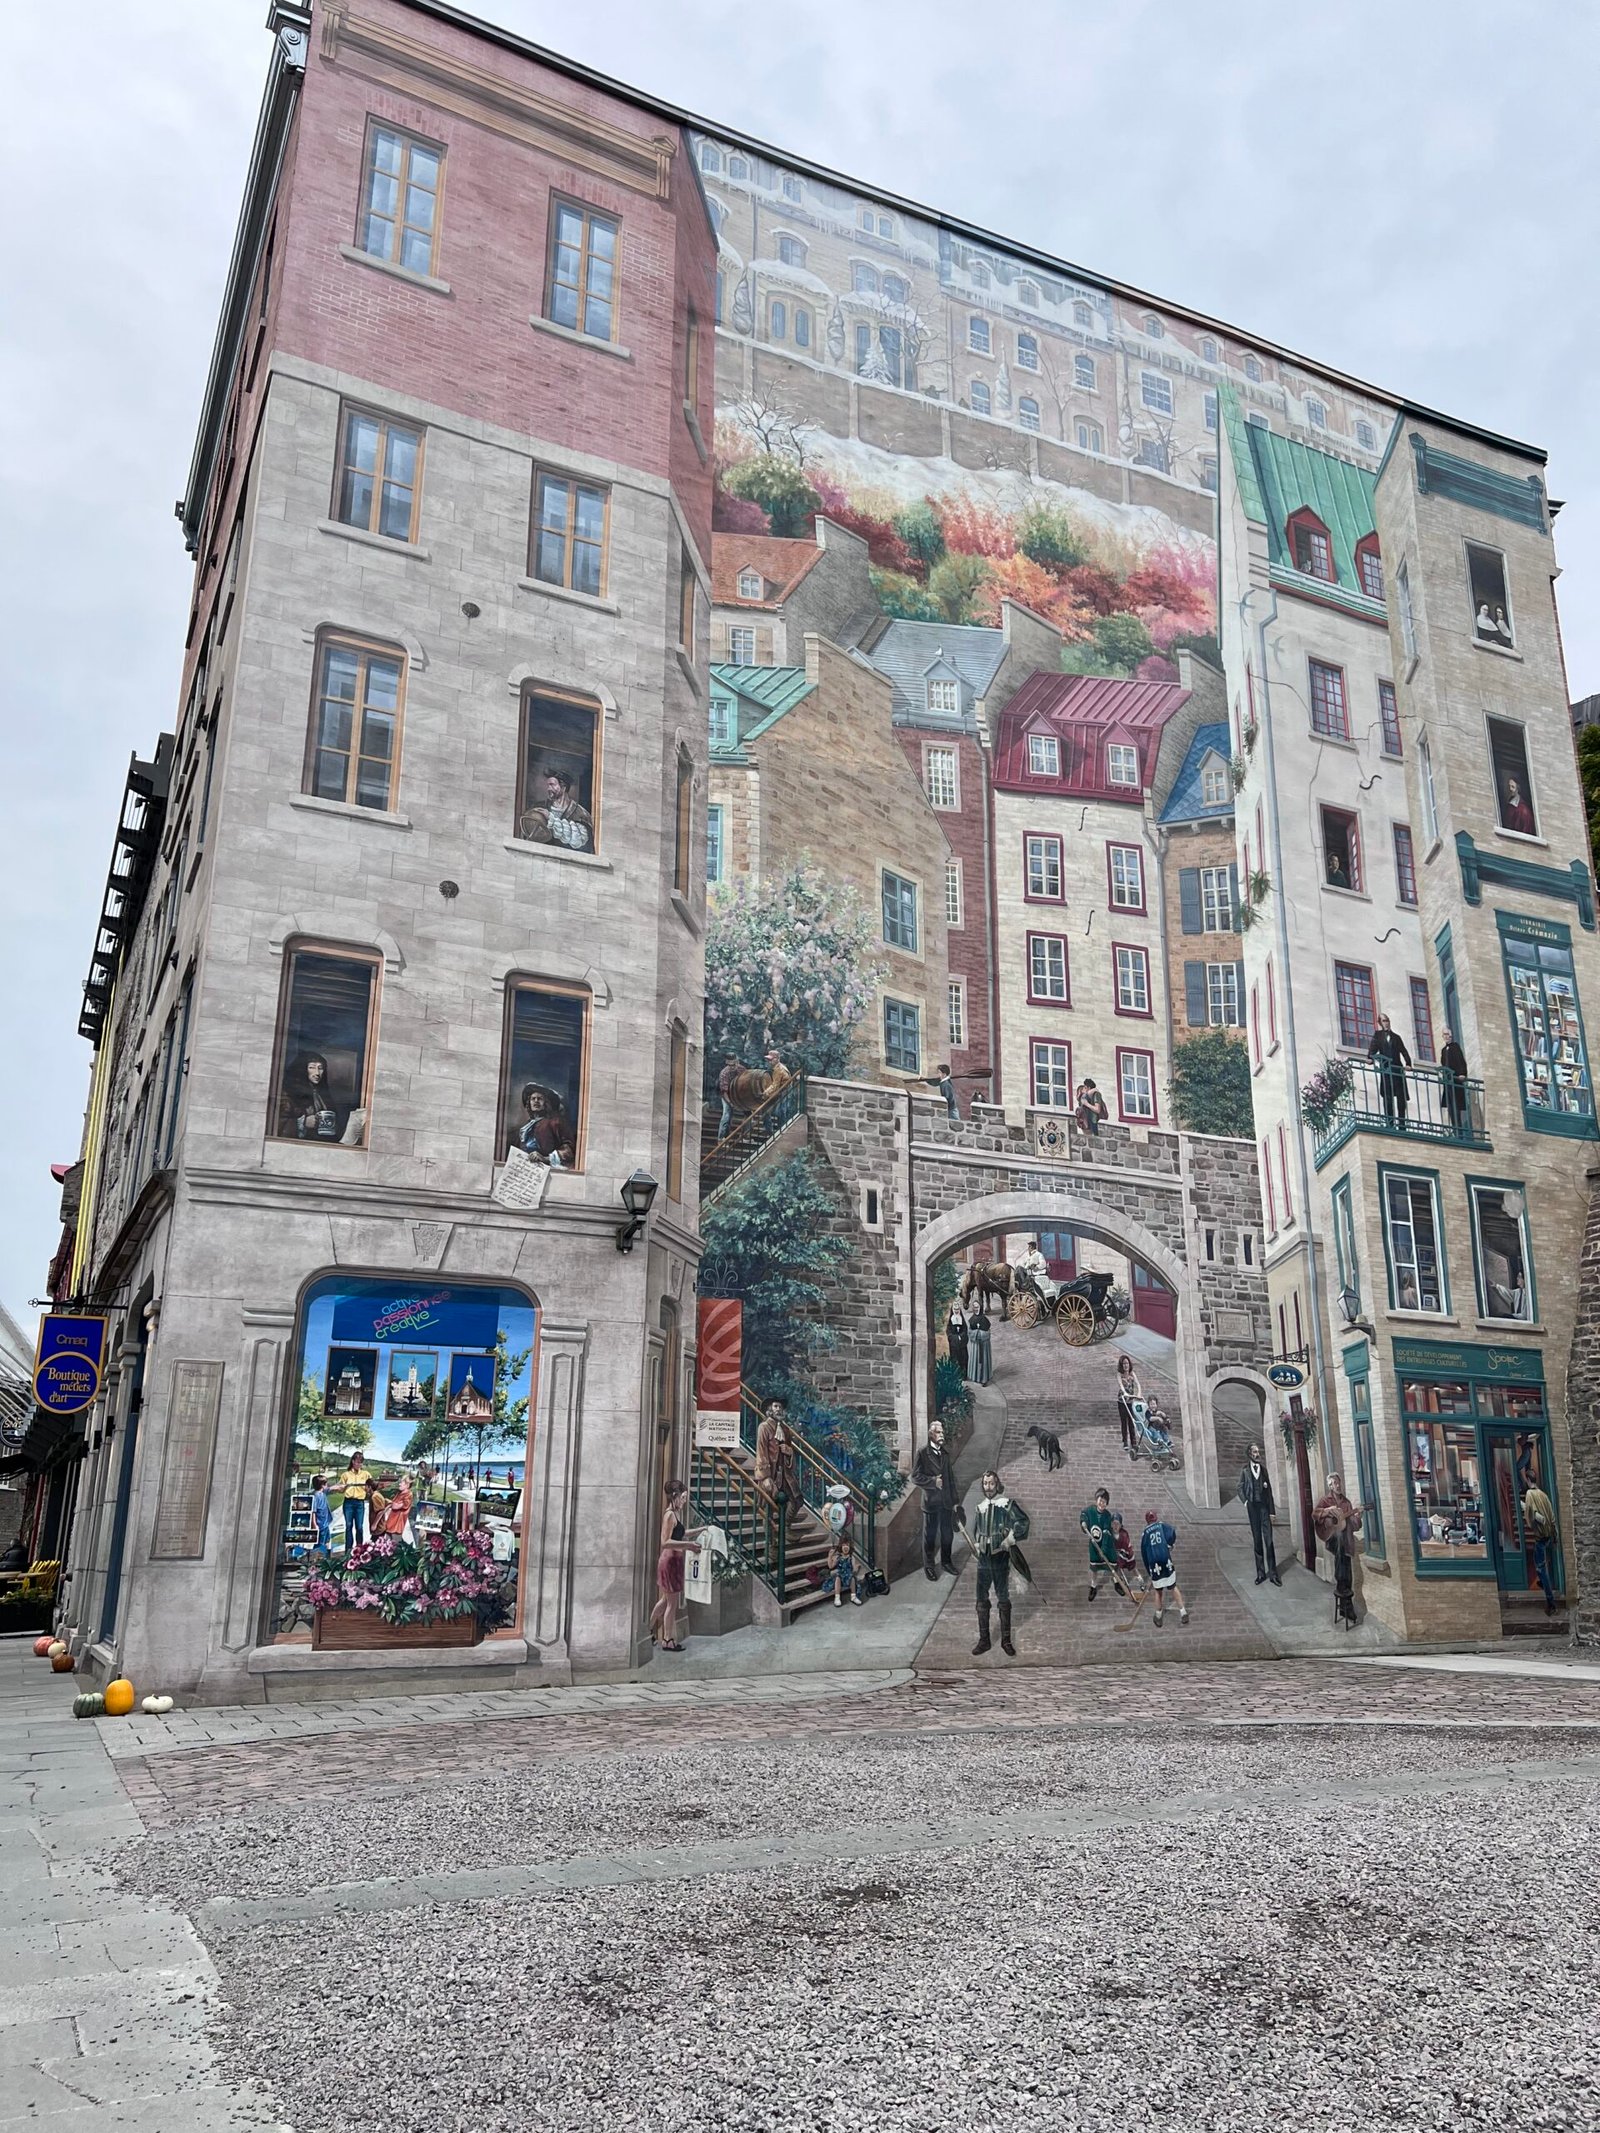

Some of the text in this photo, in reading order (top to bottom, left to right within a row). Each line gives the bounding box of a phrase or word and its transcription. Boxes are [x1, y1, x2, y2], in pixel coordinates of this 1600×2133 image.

[381, 1294, 420, 1315] active
[47, 1367, 91, 1384] Boutique
[59, 1381, 91, 1393] métiers
[1150, 1532, 1162, 1546] 26
